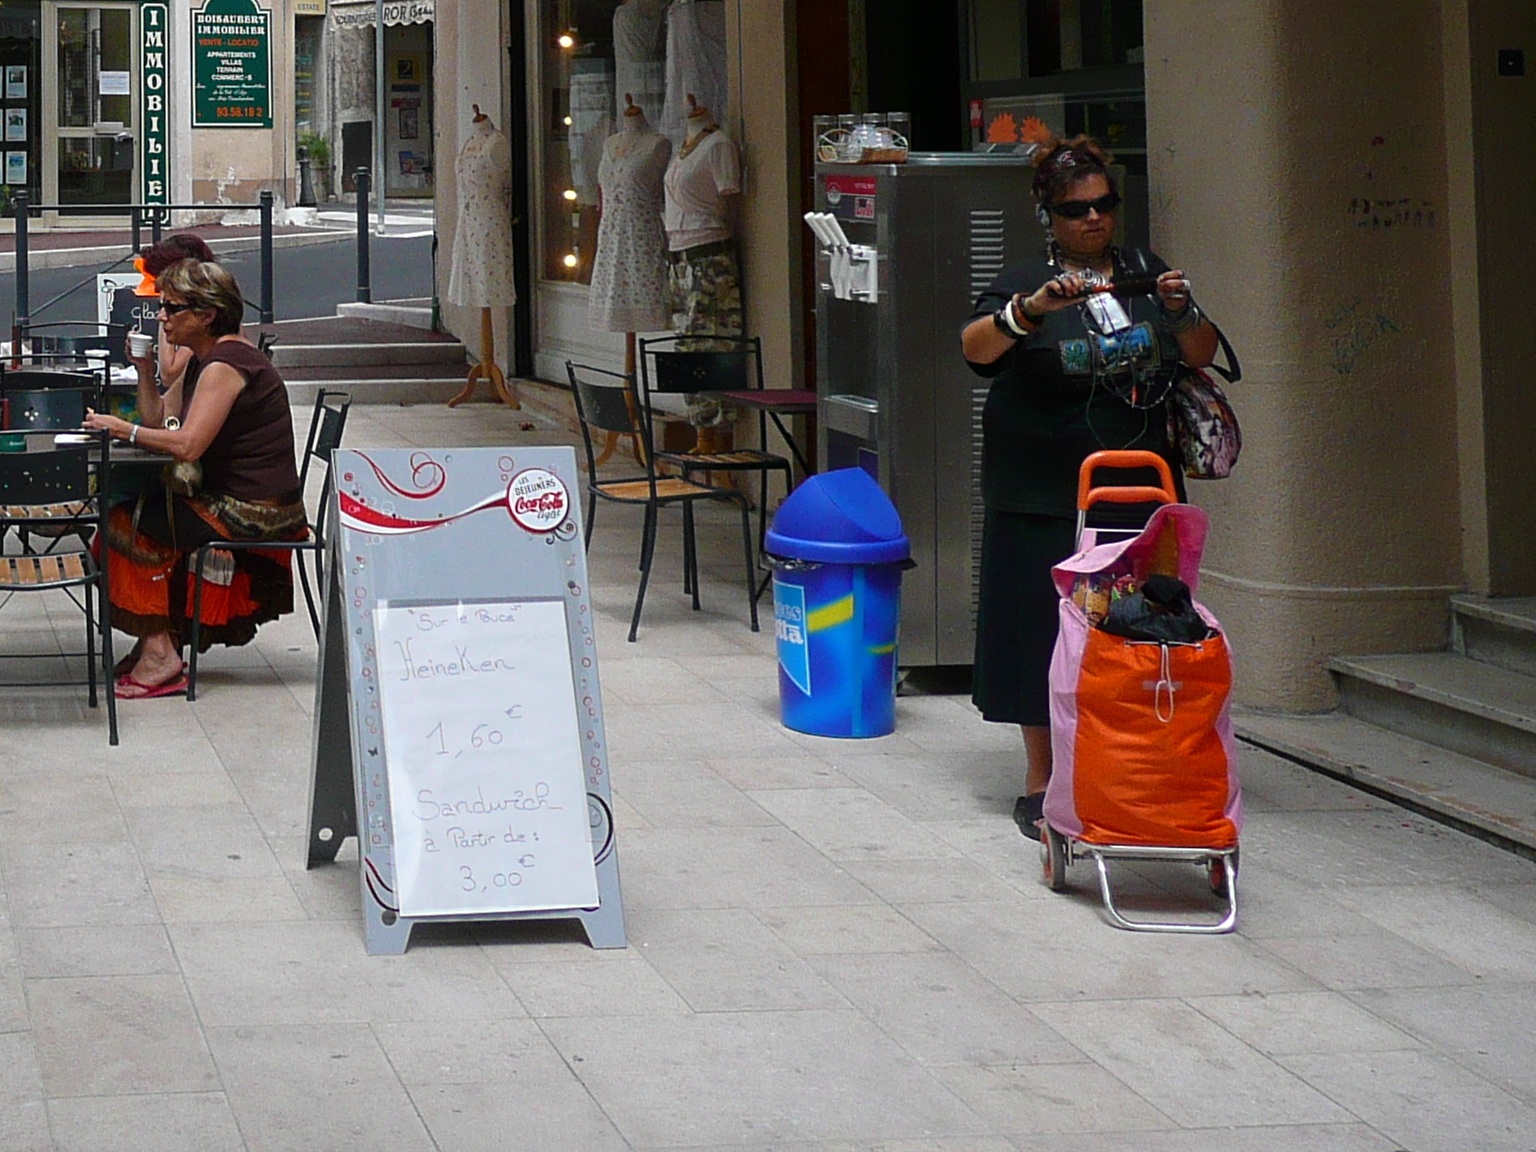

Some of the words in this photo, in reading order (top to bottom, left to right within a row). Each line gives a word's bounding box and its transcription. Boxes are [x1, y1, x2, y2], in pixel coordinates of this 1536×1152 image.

[197, 14, 266, 24] BOISAUBERT
[197, 25, 266, 35] IMMOBILIER
[198, 38, 223, 46] VENTE
[413, 781, 563, 821] Sandwich
